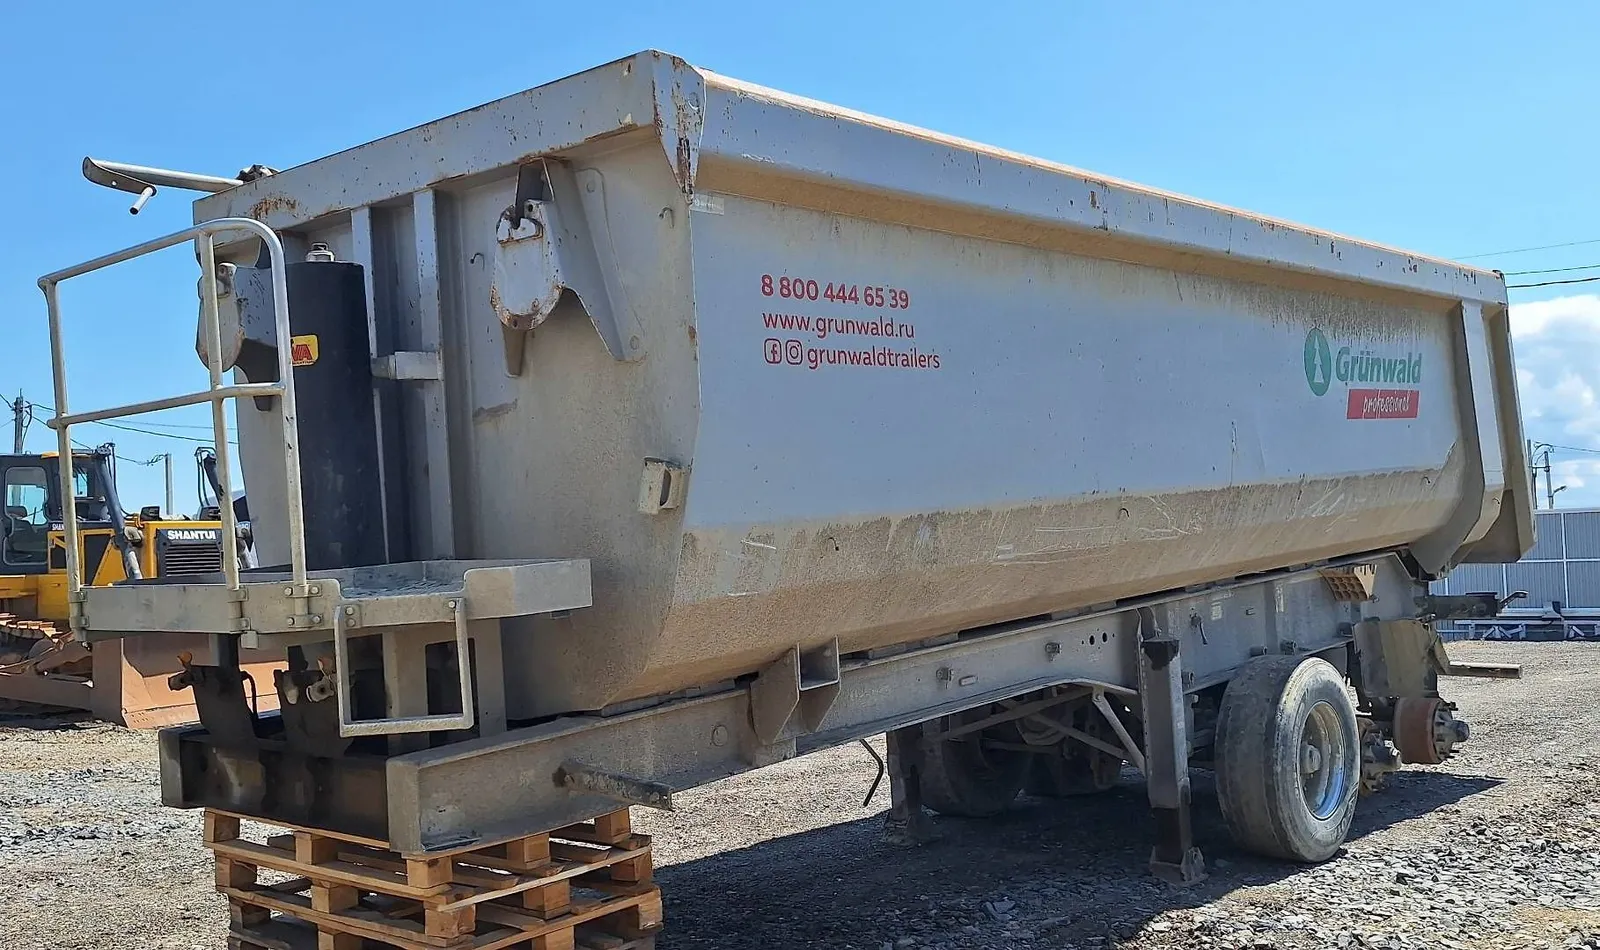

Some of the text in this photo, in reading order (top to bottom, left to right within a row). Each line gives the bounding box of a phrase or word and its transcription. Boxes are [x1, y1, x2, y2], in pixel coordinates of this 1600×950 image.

[761, 274, 909, 309] 8 800 444 65 39
[762, 312, 915, 339] www.grunwald.ru
[807, 345, 940, 370] grunwaldtrailers
[1335, 346, 1422, 383] Grünwald
[167, 530, 216, 540] SHANTUI
